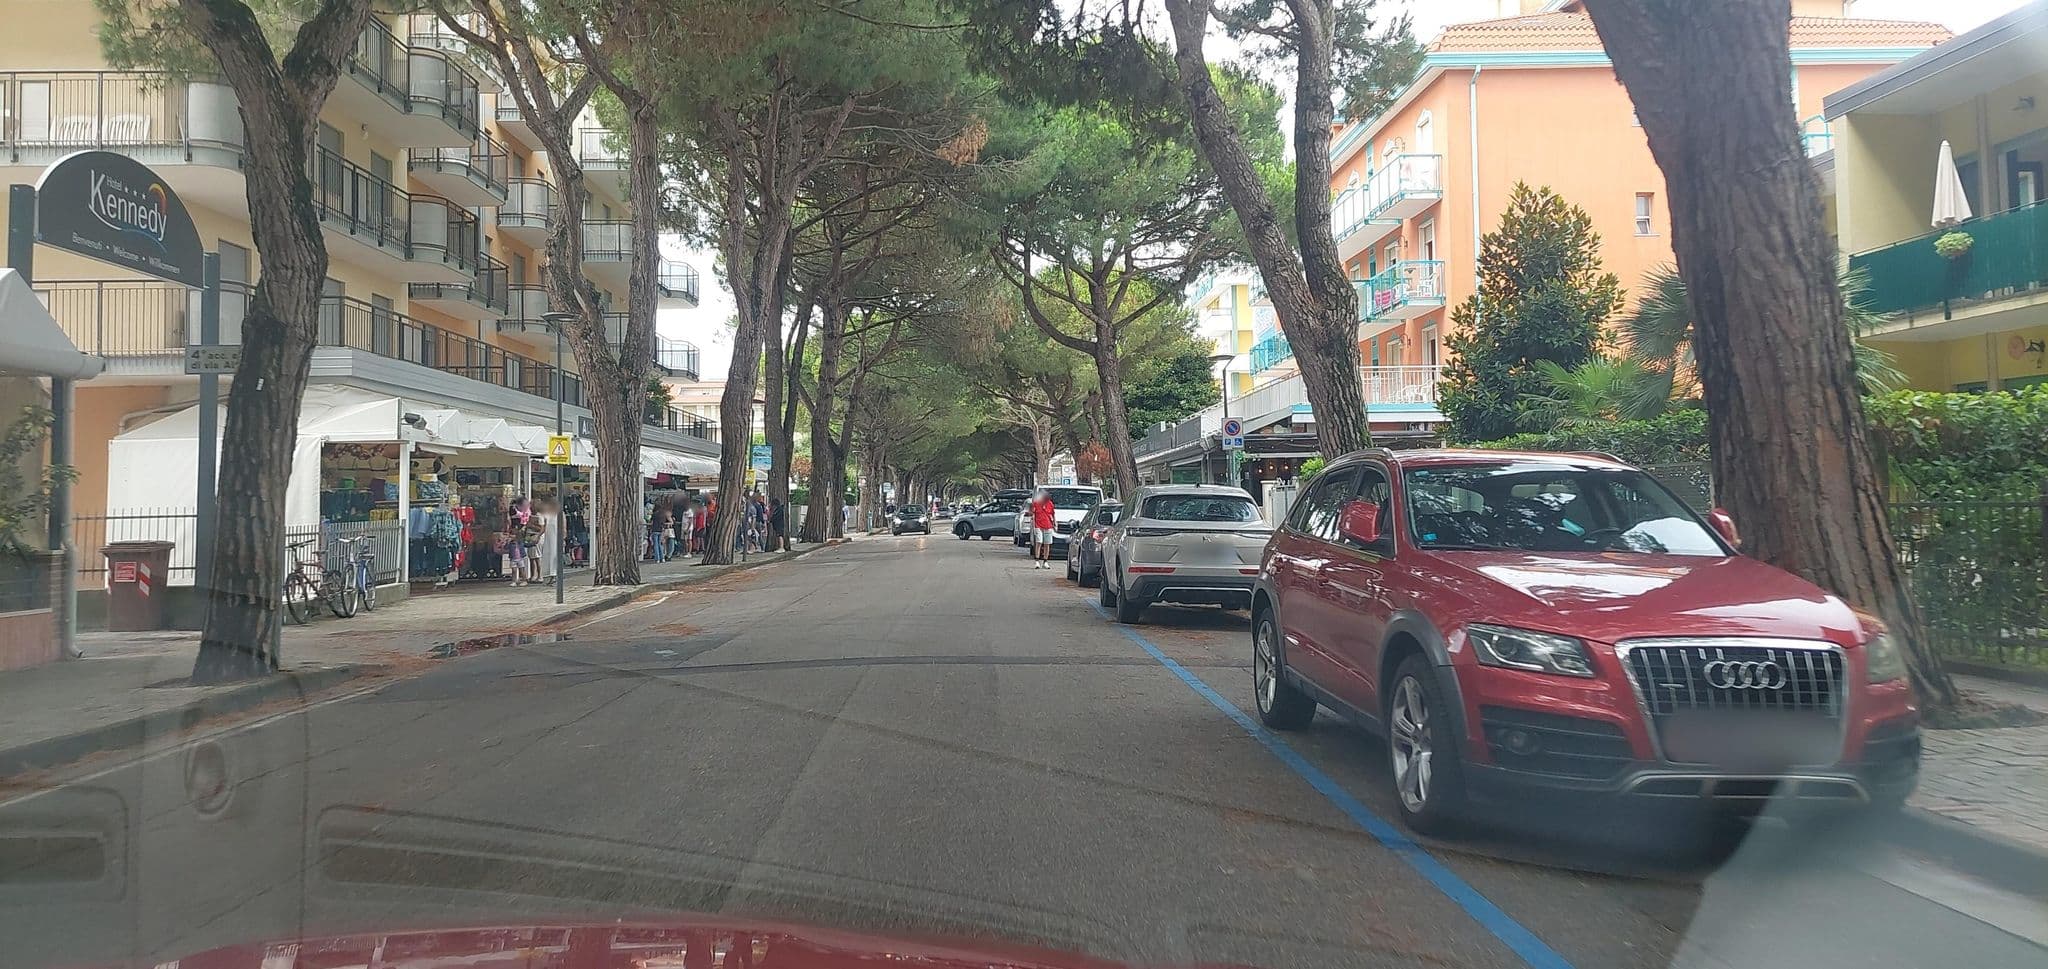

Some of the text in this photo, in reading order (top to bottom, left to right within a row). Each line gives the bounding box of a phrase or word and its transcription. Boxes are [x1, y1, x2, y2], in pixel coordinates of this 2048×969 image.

[106, 175, 122, 191] Hotel
[91, 169, 167, 241] Kennedy
[113, 245, 139, 262] Welcome
